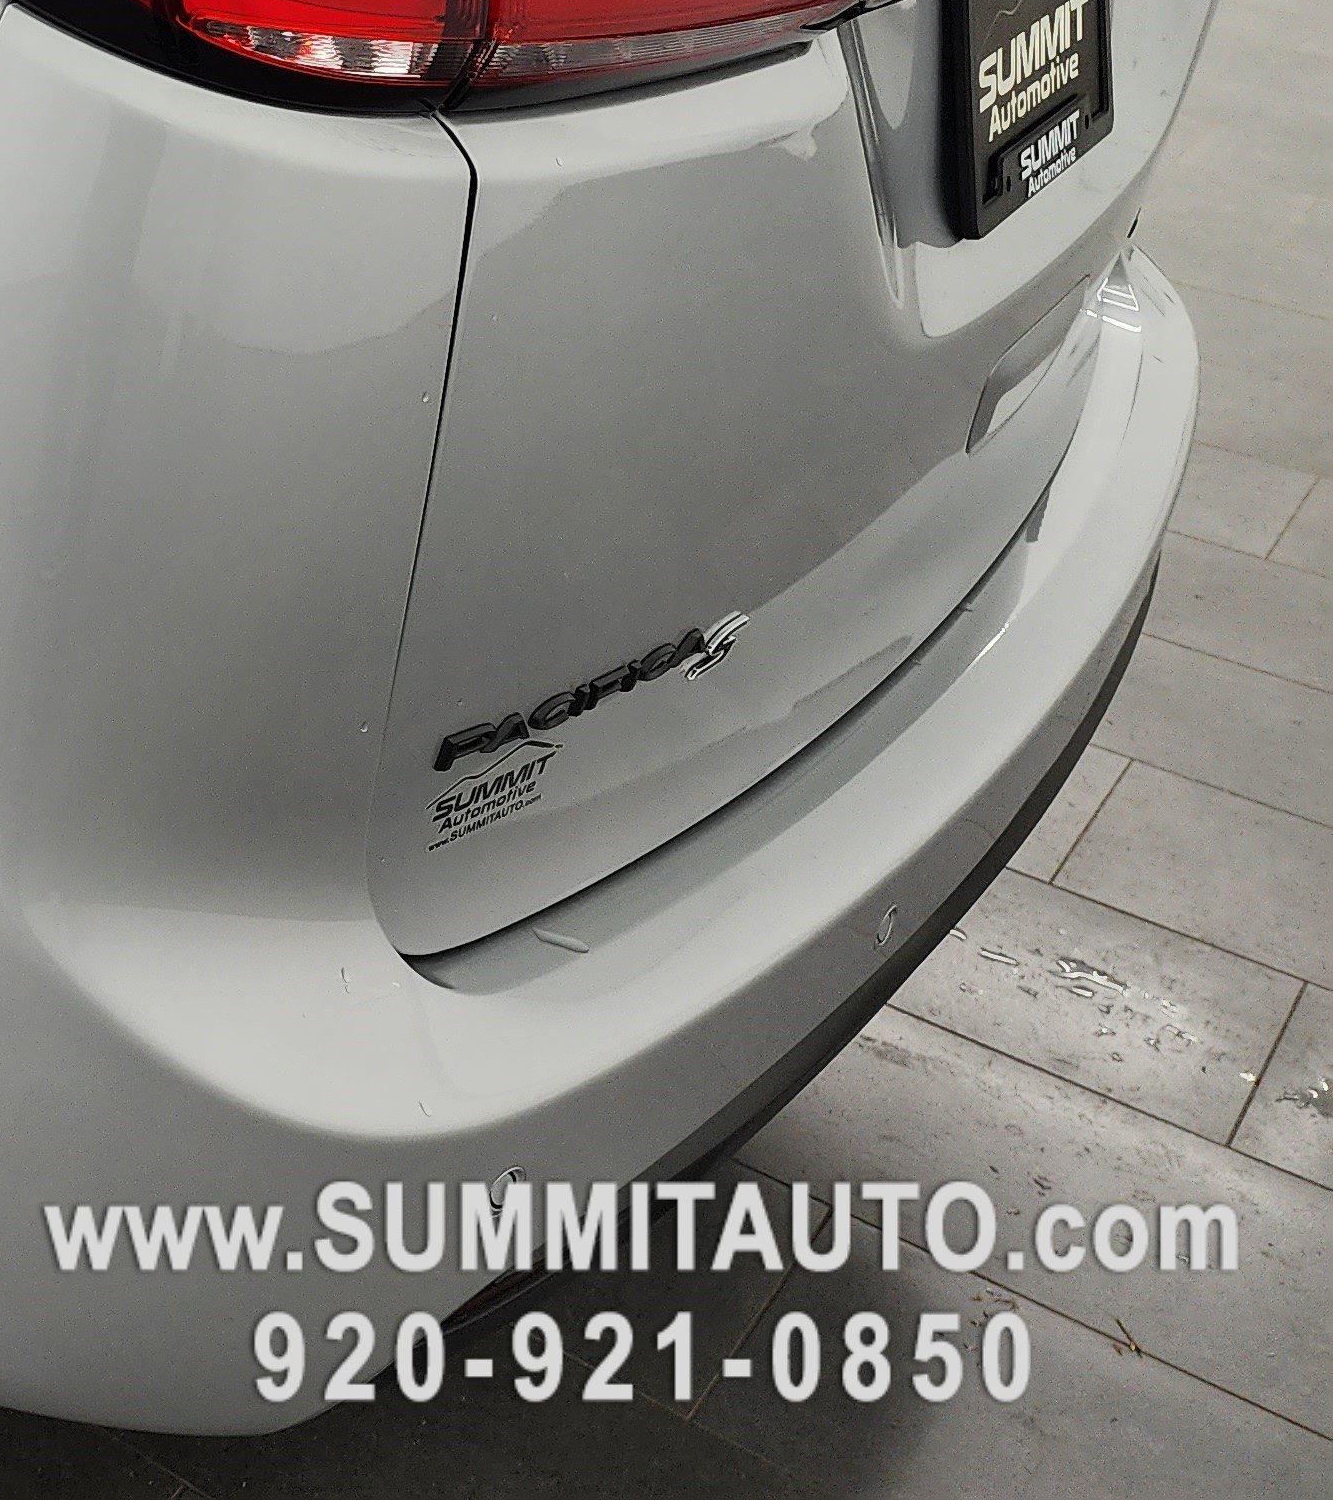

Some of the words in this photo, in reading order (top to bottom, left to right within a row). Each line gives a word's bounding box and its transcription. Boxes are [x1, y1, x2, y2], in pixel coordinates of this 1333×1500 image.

[989, 53, 1080, 143] Automotive
[1020, 110, 1081, 180] SUMMIT
[1026, 147, 1077, 198] Automotive
[432, 750, 557, 823] SUMMIT
[438, 780, 537, 834] Automotive
[427, 793, 543, 852] www.SUMMITAUTO.com
